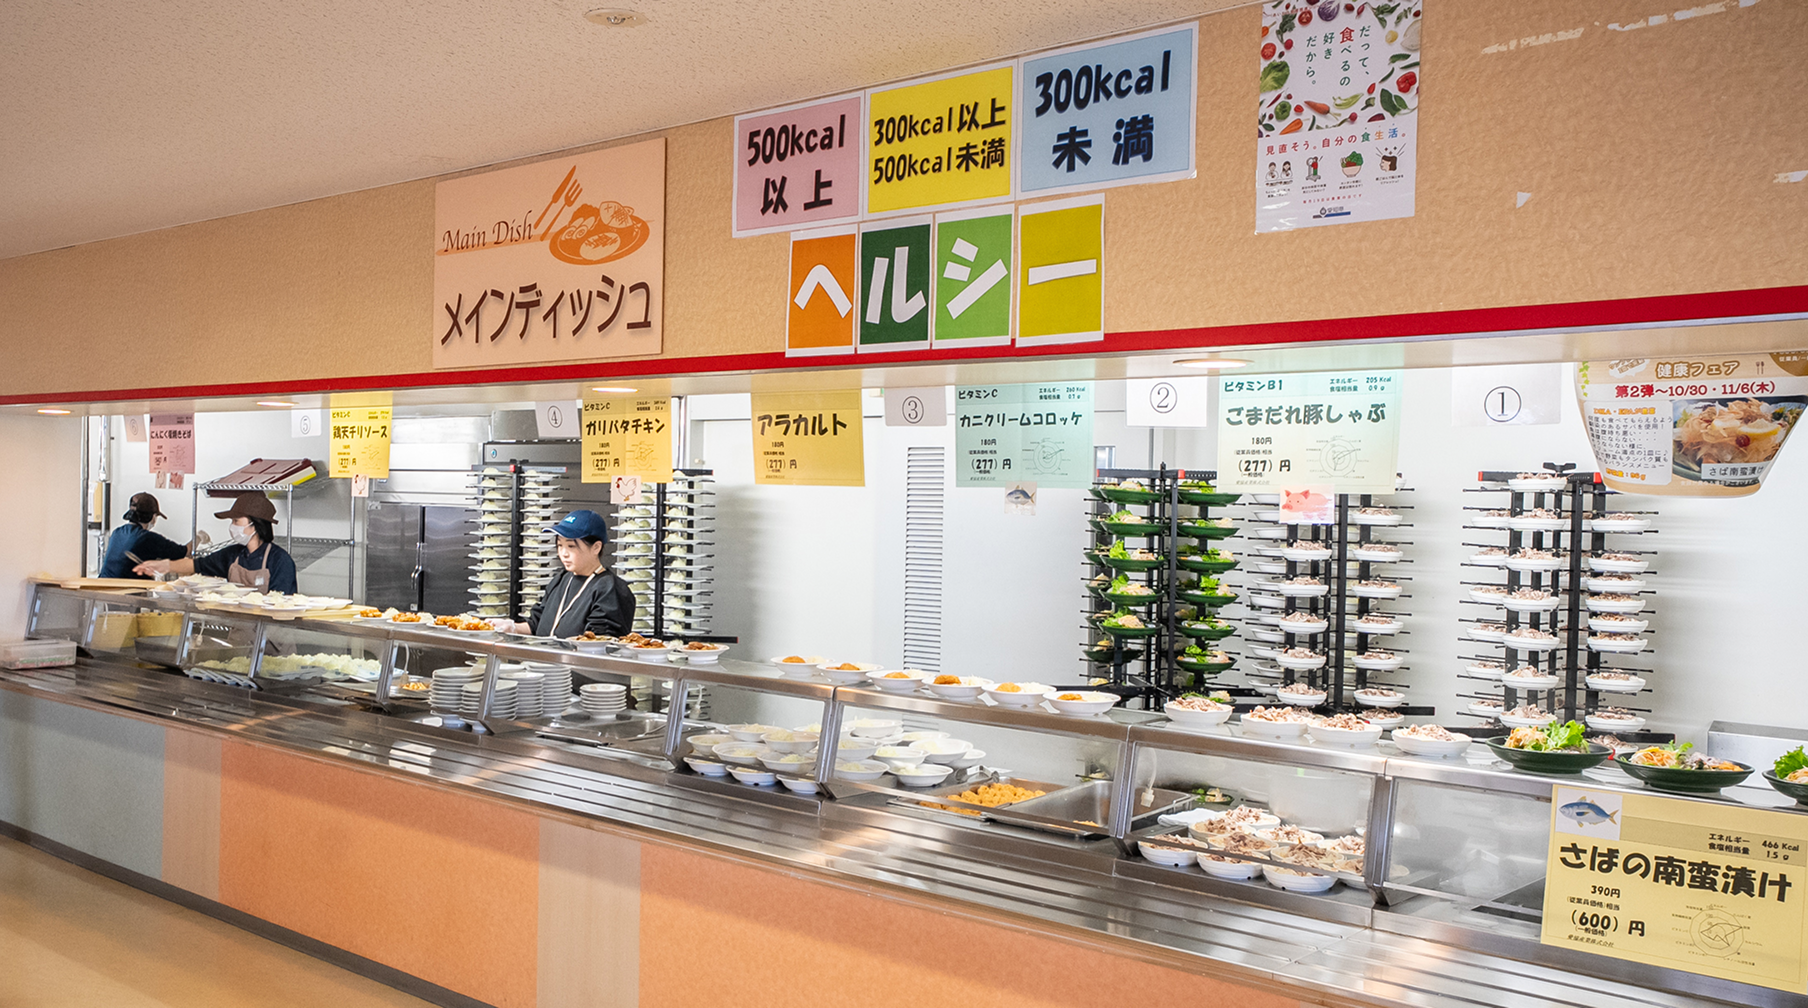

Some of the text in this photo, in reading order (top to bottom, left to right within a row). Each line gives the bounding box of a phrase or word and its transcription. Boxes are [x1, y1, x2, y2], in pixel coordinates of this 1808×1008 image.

[1323, 32, 1335, 60] 好き
[1339, 26, 1355, 87] 食べるの
[1358, 25, 1371, 75] だって、
[1305, 36, 1318, 85] だから。
[1035, 50, 1171, 117] 300kcal
[746, 113, 846, 166] 500kcal
[442, 210, 533, 252] Main Dish
[794, 236, 1097, 324] ヘルシー
[441, 274, 651, 346] メインディッシュ
[1366, 376, 1378, 384] 205
[1655, 360, 1740, 380] 健康フェア
[958, 389, 998, 400] ビタミンC
[1224, 379, 1283, 392] ビタミンB1
[584, 402, 610, 411] ビタミンC
[1226, 403, 1386, 426] ごまだれ豚しゃぶ
[586, 418, 665, 435] ガリバタチキン
[757, 413, 847, 436] アラカルト
[960, 411, 1083, 427] カニクリームコロッケ
[1251, 437, 1272, 445] 180円
[972, 458, 1011, 470] (277) 円
[1238, 459, 1291, 472] (277) 円
[1708, 833, 1800, 852] エネルギー 466 Kcal
[1708, 842, 1750, 855] 食塩相当量
[1559, 842, 1793, 903] さばの南蛮漬け
[1590, 885, 1621, 899] 390円
[1571, 909, 1646, 937] (600) 円
